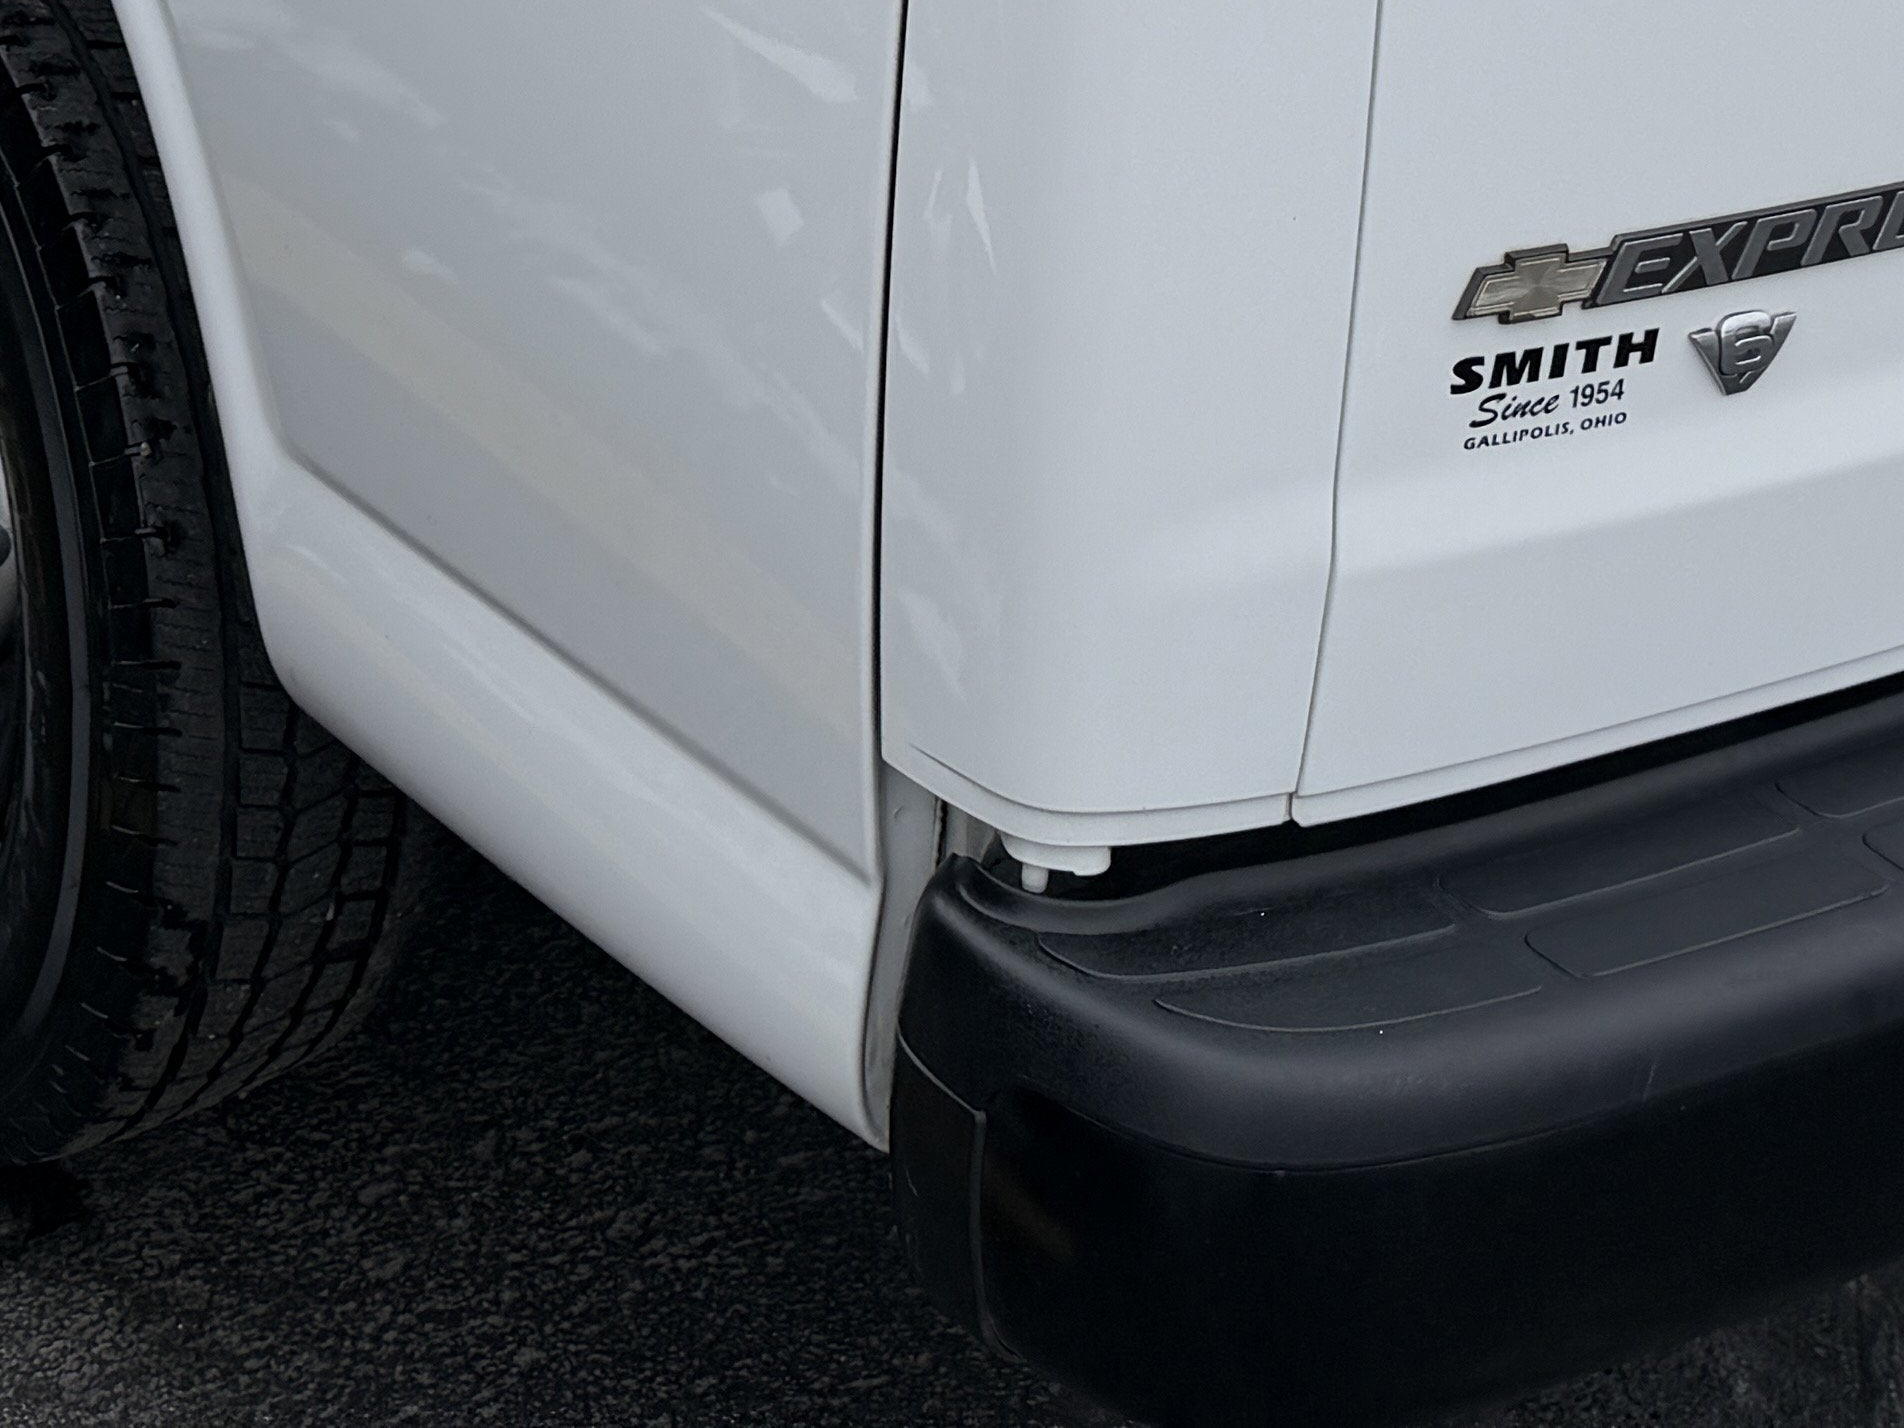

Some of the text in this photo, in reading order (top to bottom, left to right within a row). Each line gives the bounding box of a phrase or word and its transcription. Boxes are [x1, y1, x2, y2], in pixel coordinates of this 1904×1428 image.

[1449, 327, 1660, 395] SMITH
[1469, 378, 1625, 429] Since 1954
[1462, 411, 1627, 450] GALLIPOLIS, OHIO
